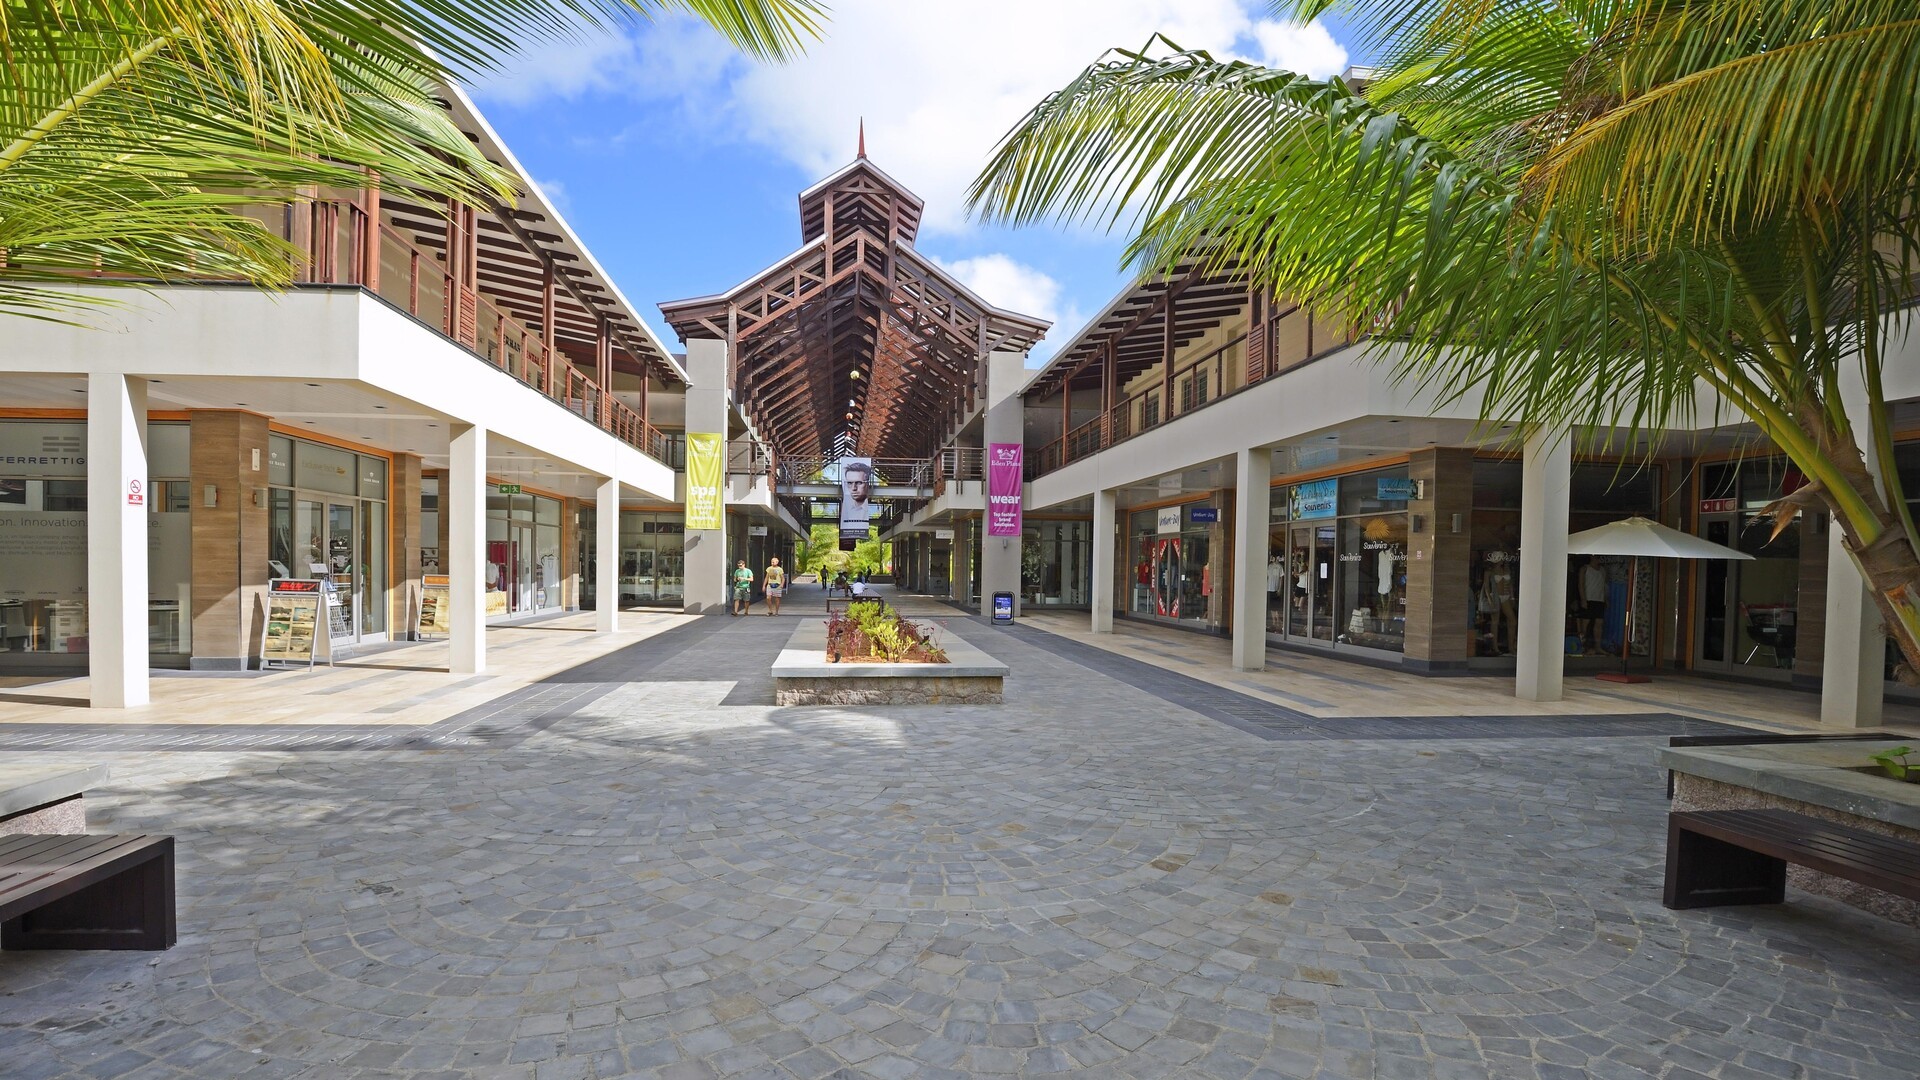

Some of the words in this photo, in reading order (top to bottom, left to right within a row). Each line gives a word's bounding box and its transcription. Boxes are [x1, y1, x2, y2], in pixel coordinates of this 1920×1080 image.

[0, 457, 86, 465] FERRETTIG
[690, 486, 717, 499] spa
[990, 495, 1021, 504] wear
[1304, 501, 1332, 512] Souvenirs
[1363, 540, 1388, 550] Souvenirs
[1339, 552, 1362, 562] Souvenirs
[1389, 551, 1409, 562] Souven
[1486, 551, 1520, 564] Souveni
